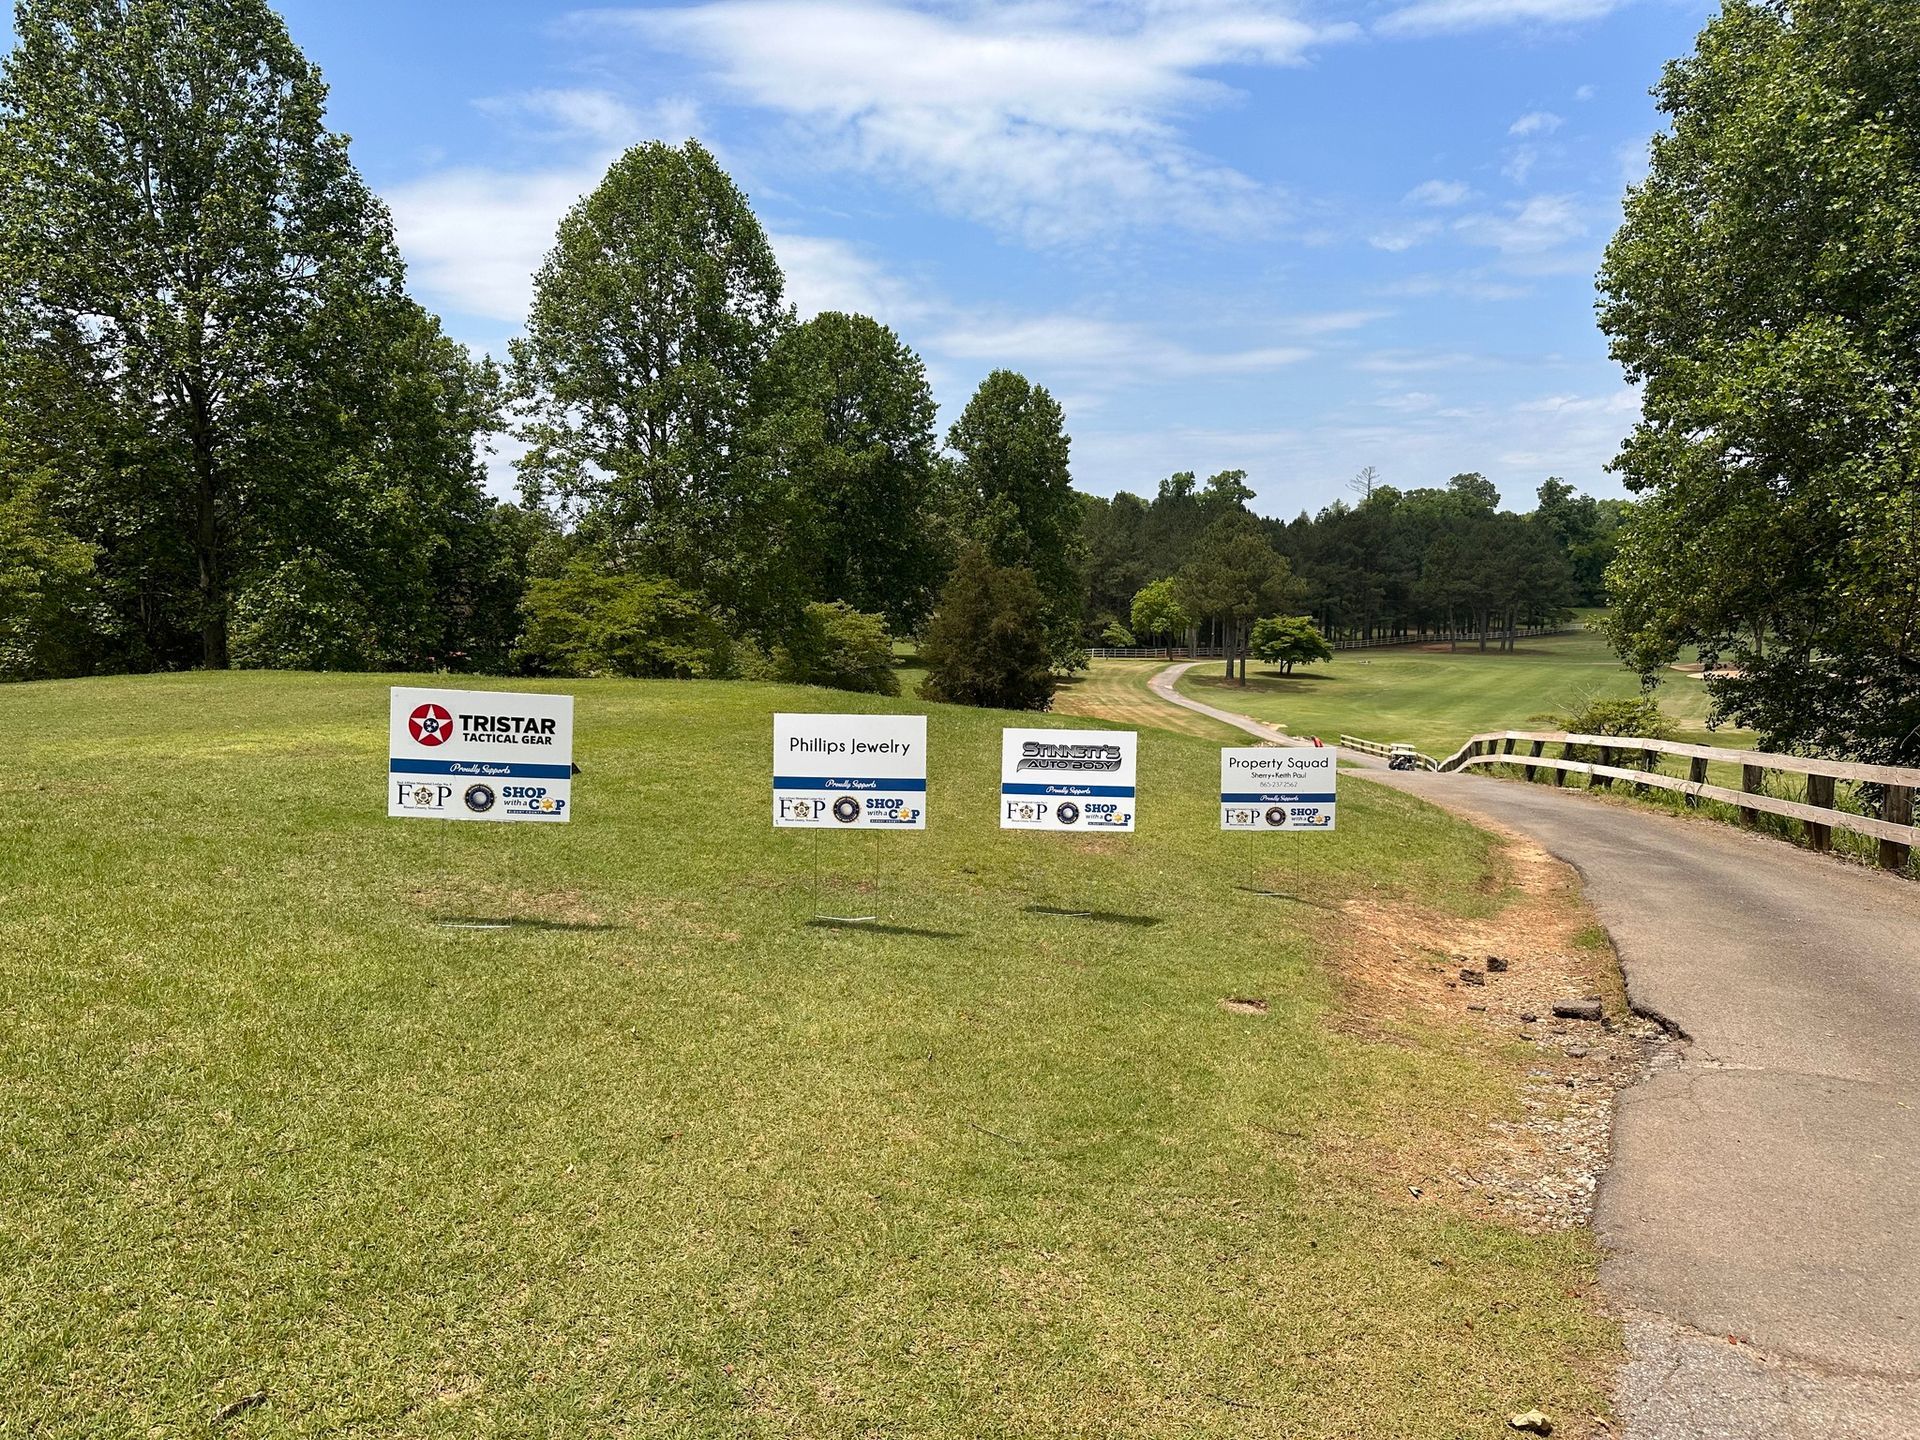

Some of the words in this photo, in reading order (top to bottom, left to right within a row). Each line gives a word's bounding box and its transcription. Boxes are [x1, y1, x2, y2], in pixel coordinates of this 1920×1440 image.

[459, 714, 556, 735] TRISTAR
[463, 732, 518, 744] TACTICAL
[521, 735, 552, 745] GEAR
[790, 737, 846, 755] Phillips
[850, 738, 911, 756] Jewelry
[1022, 741, 1121, 759] STINNETT'S
[449, 763, 481, 774] Proudly
[482, 765, 511, 775] Supports
[1027, 760, 1067, 769] AUTO
[1072, 762, 1114, 770] BODY
[1229, 757, 1283, 770] Property
[1287, 757, 1329, 769] Squad
[825, 779, 851, 789] Proudly
[852, 780, 877, 789] Supports
[502, 786, 547, 799] SHOP
[1045, 786, 1069, 794] Proudly
[1069, 787, 1091, 795] Supports
[866, 799, 904, 809] SHOP
[1084, 803, 1118, 814] SHOP
[1290, 808, 1319, 816] SHOP
